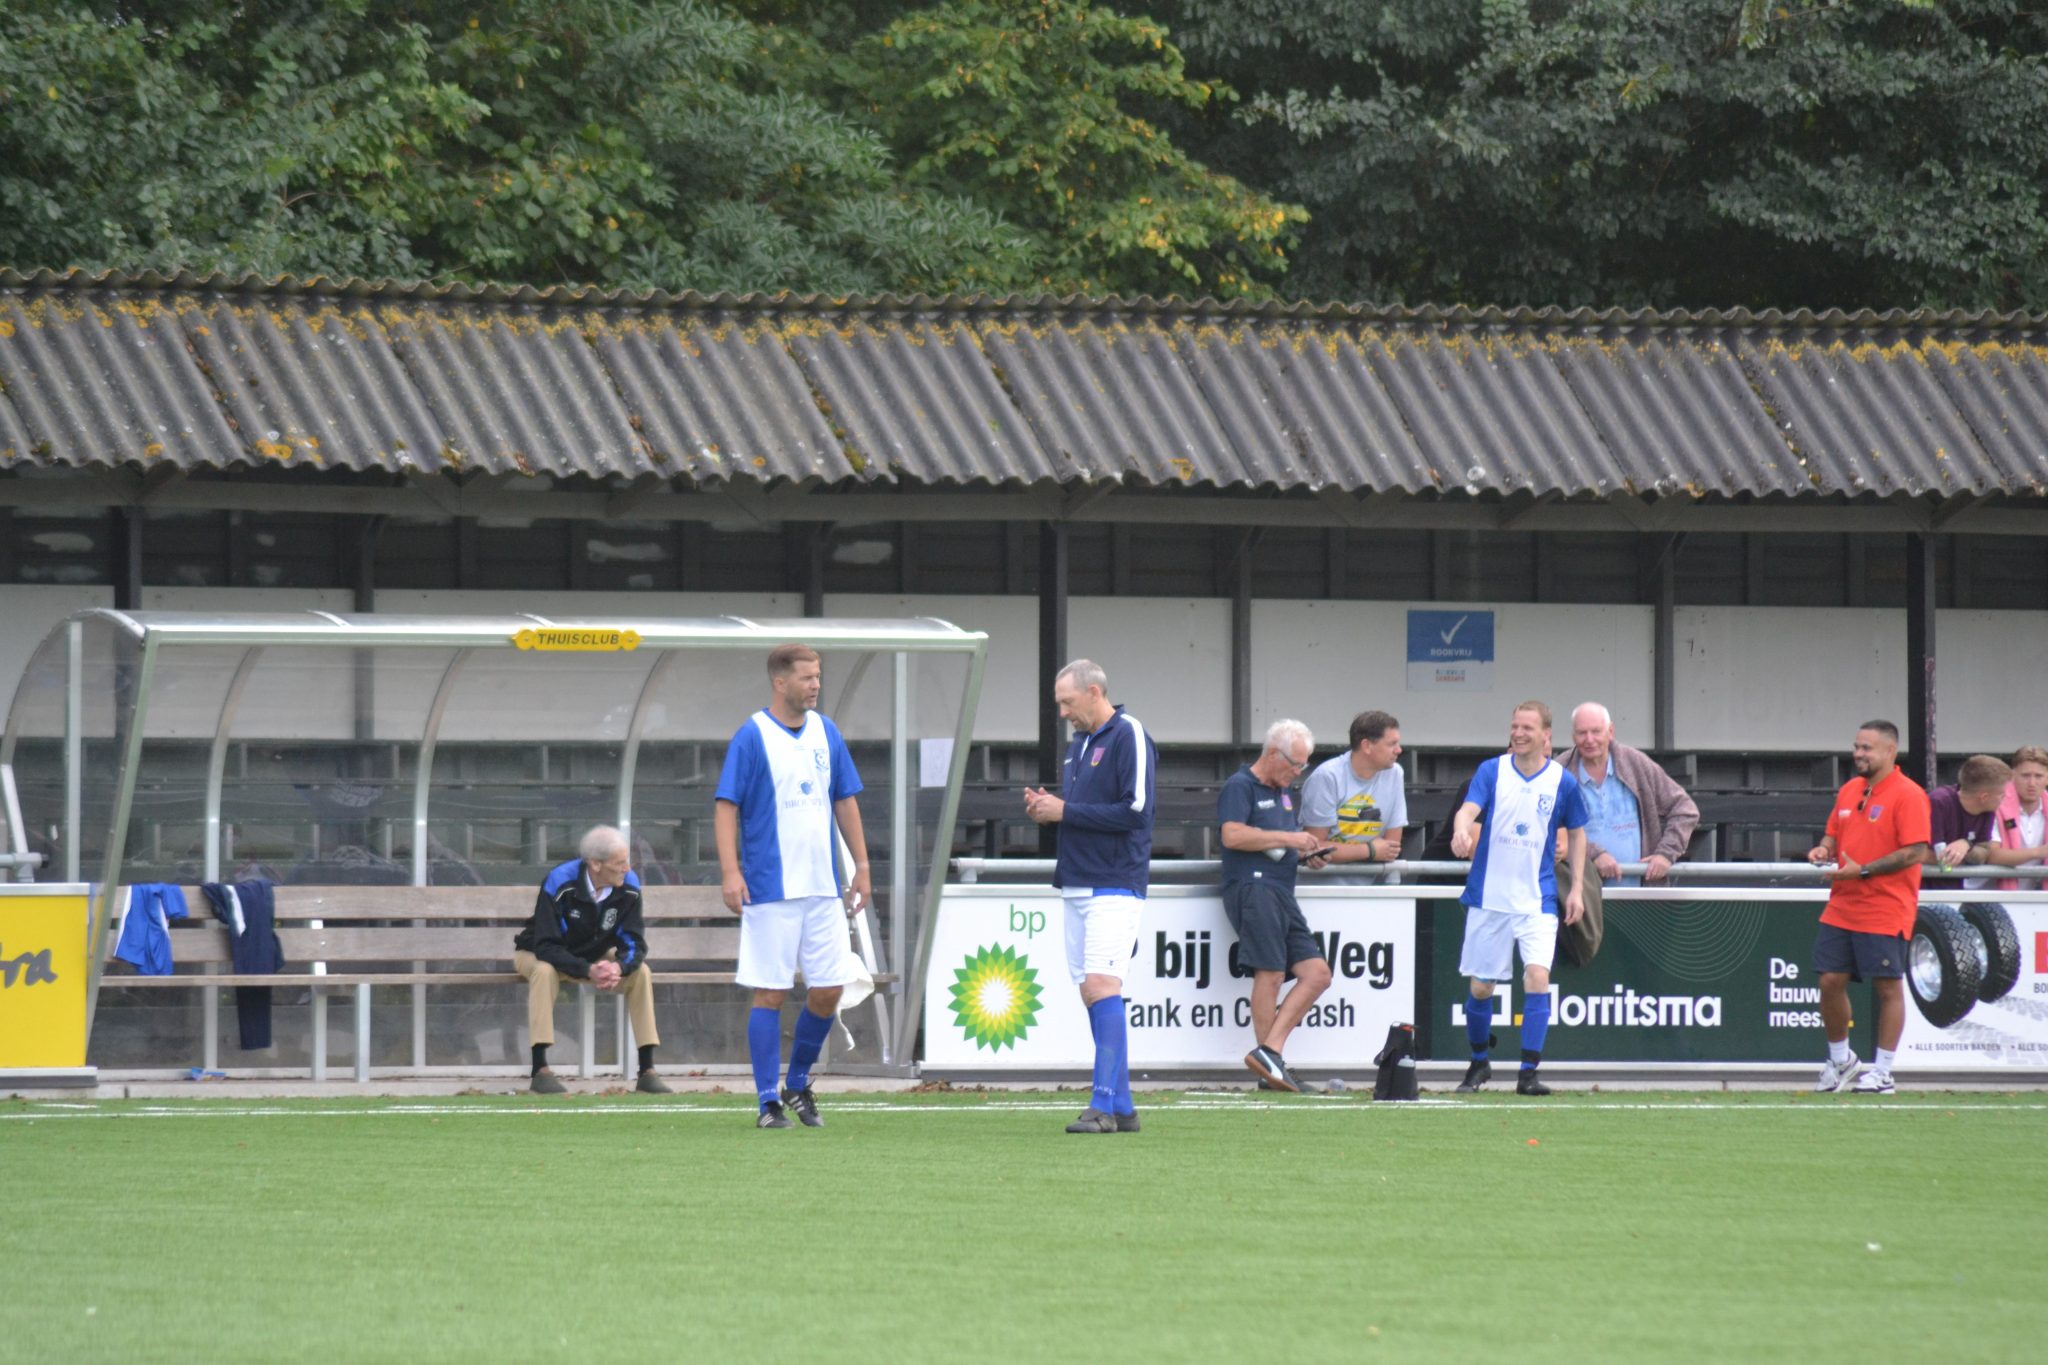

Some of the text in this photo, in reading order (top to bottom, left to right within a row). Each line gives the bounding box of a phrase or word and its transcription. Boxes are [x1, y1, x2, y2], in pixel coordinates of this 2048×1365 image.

[538, 633, 620, 645] THUISCLUB
[1009, 903, 1046, 939] bp
[0, 941, 59, 990] ra
[1155, 931, 1211, 989] bij
[1770, 957, 1799, 980] De
[1769, 982, 1821, 1004] bouw
[1191, 1003, 1224, 1028] en
[1769, 1011, 1826, 1028] mees
